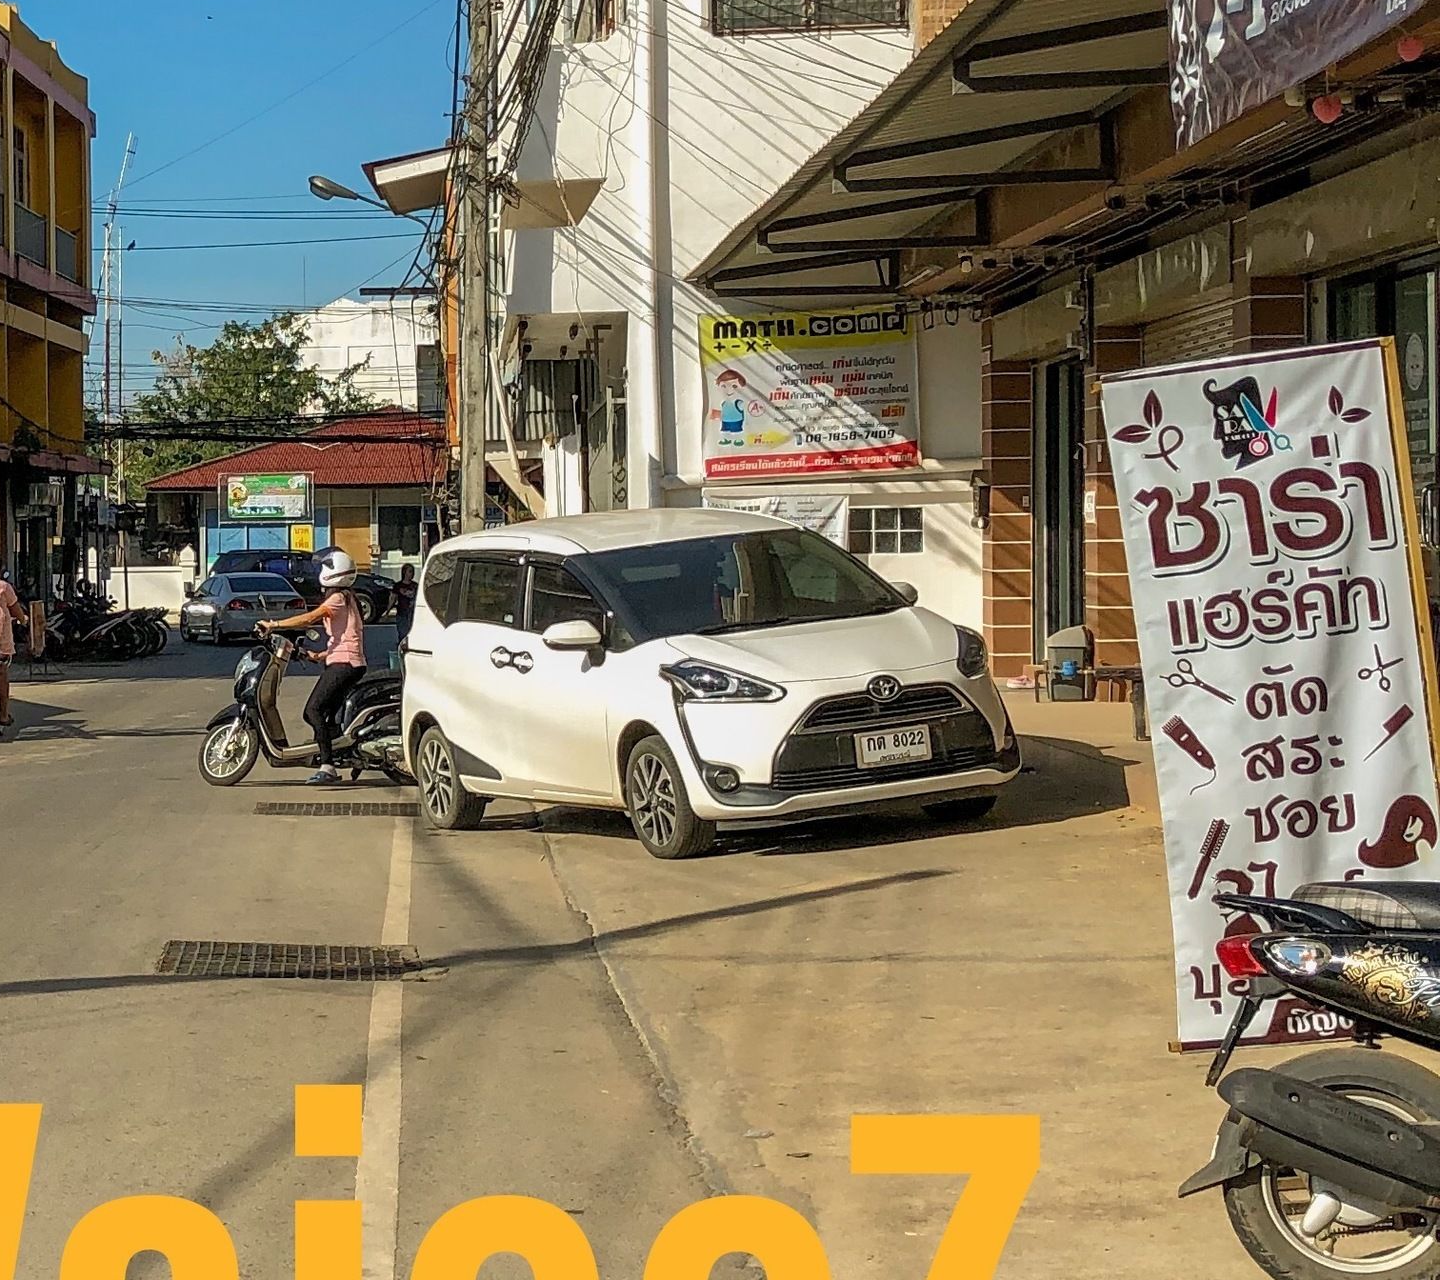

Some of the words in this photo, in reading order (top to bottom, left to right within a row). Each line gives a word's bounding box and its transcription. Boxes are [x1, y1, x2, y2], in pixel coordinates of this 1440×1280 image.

[1132, 433, 1393, 572] ซาร่า
[1167, 567, 1384, 648] แฮร์คัท
[1245, 663, 1329, 720] ตัด
[892, 730, 925, 748] 8022
[1241, 734, 1345, 782] สระ
